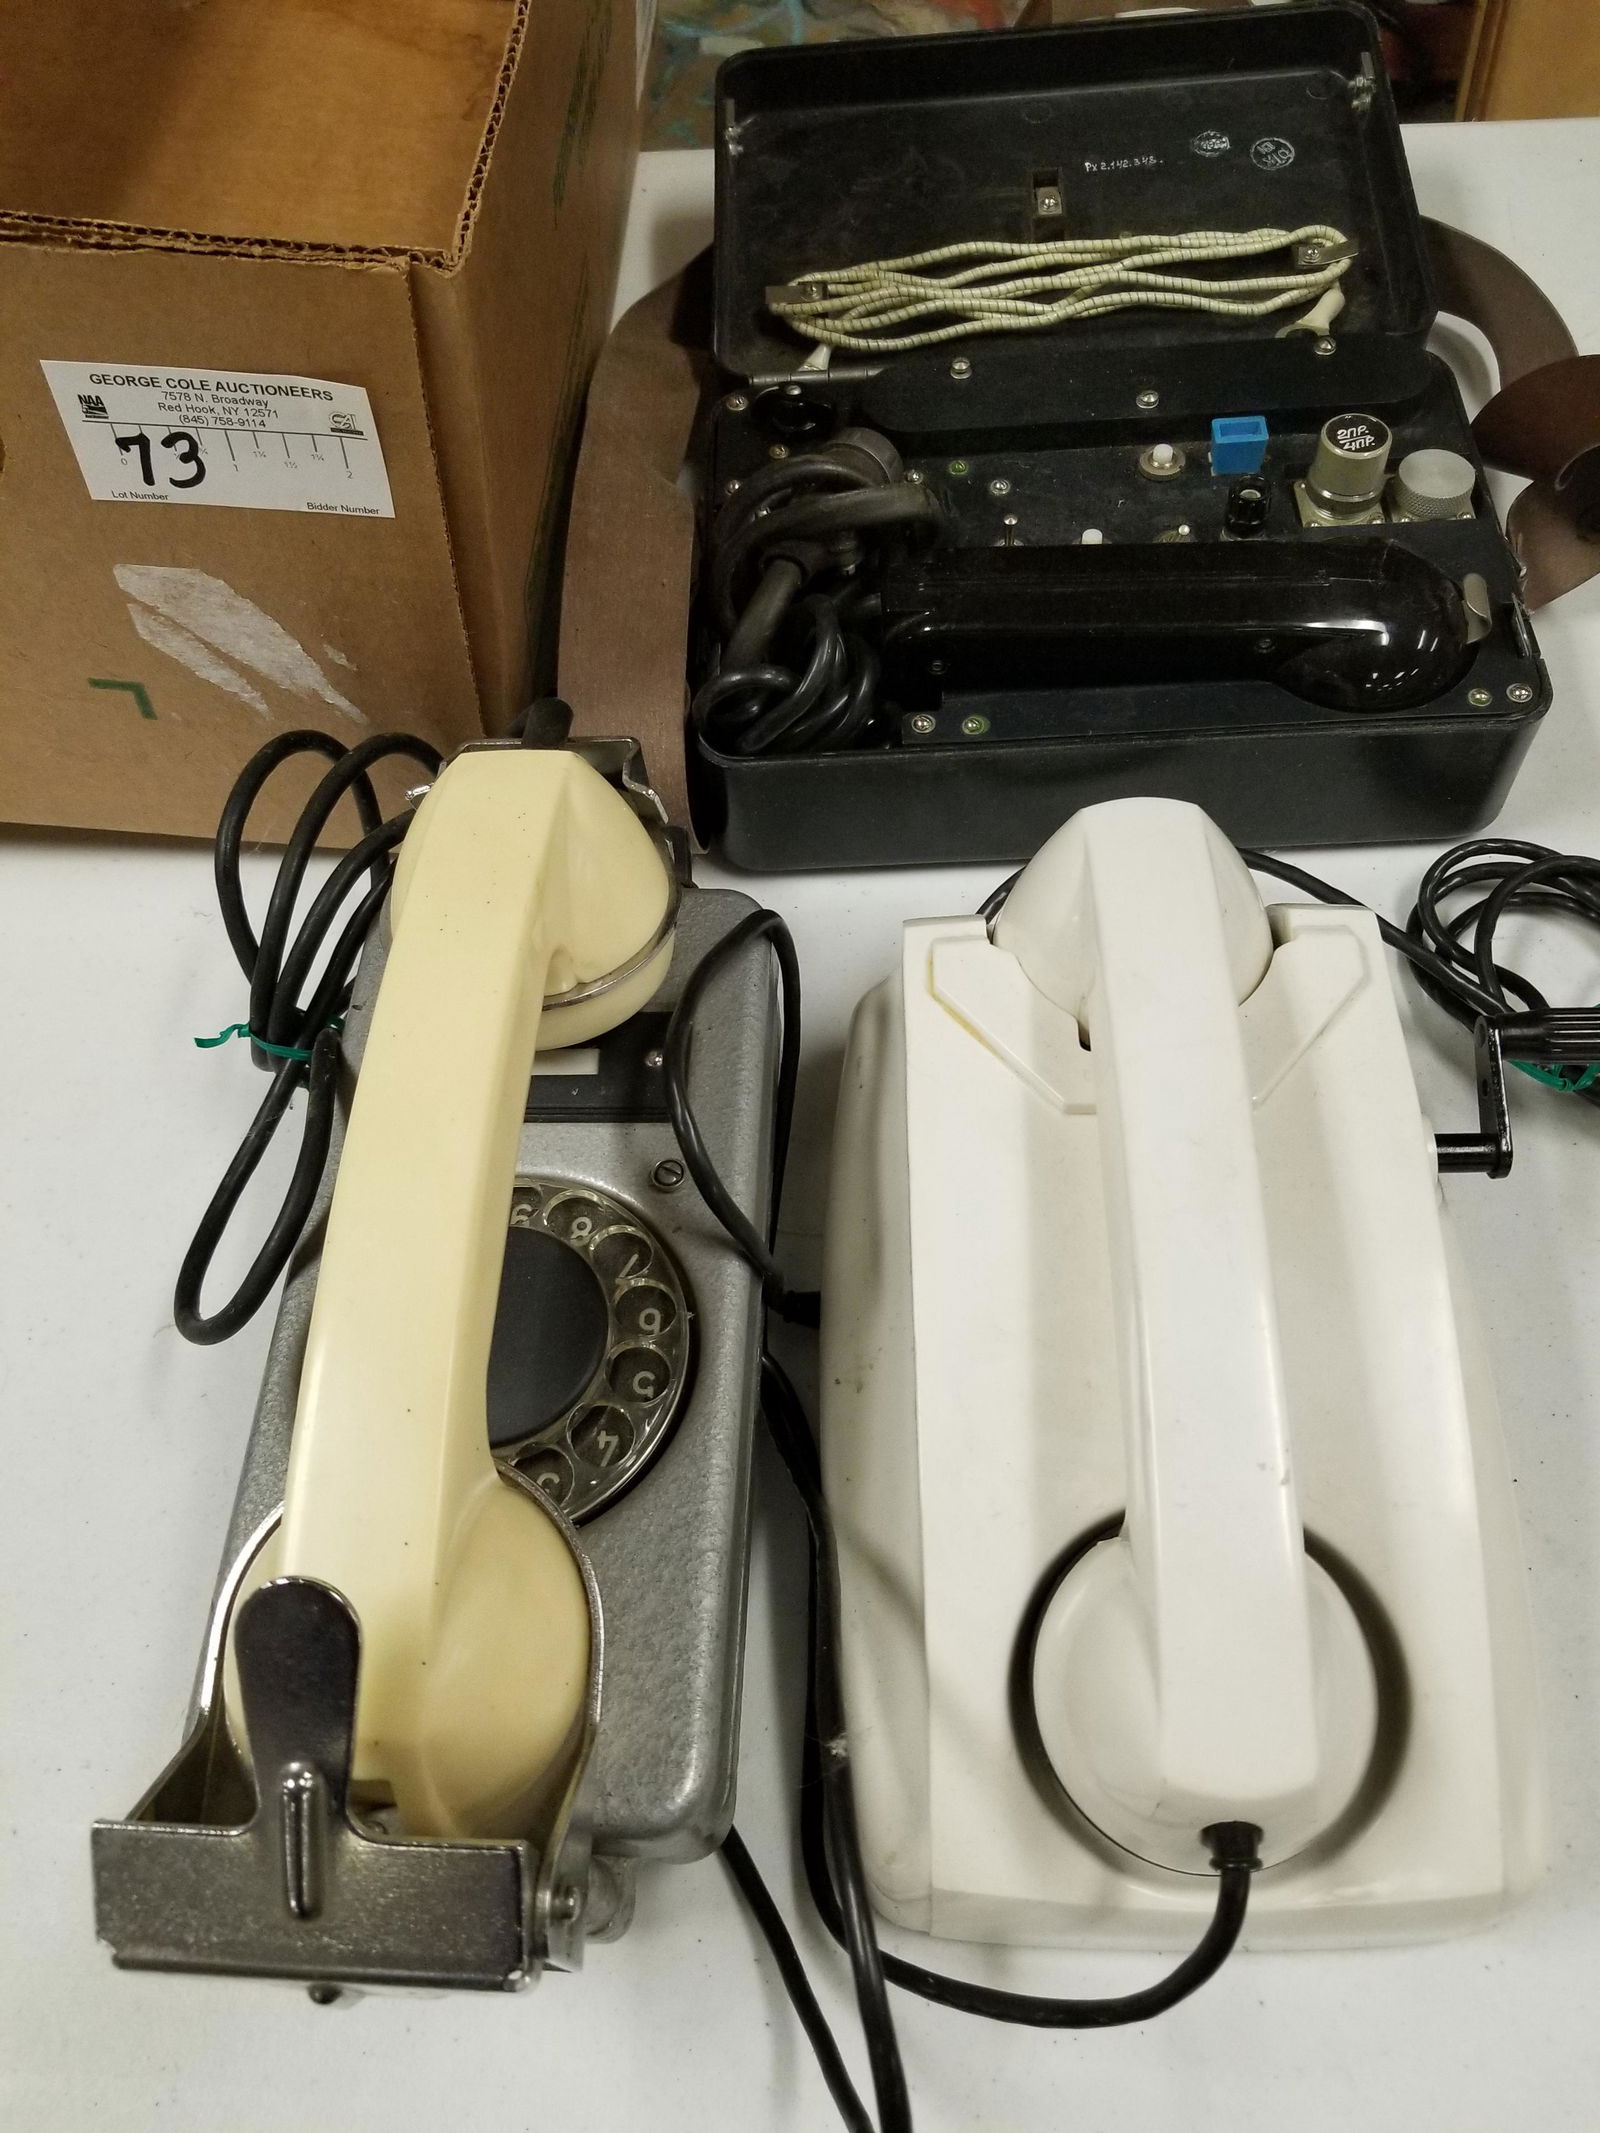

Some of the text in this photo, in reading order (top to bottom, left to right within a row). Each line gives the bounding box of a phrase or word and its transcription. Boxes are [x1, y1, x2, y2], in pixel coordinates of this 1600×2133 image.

[89, 373, 334, 402] GEORGE COLE AUCTIONEERS
[77, 394, 104, 407] NAA
[161, 391, 269, 409] 7578 N. Broadway
[157, 402, 279, 419] Red Hook, NY 12571
[179, 415, 267, 429] (845) 758-9114
[114, 431, 206, 489] 73
[111, 489, 169, 501] Lot Number
[306, 502, 381, 515] Bidder Number
[597, 1429, 619, 1468] 4
